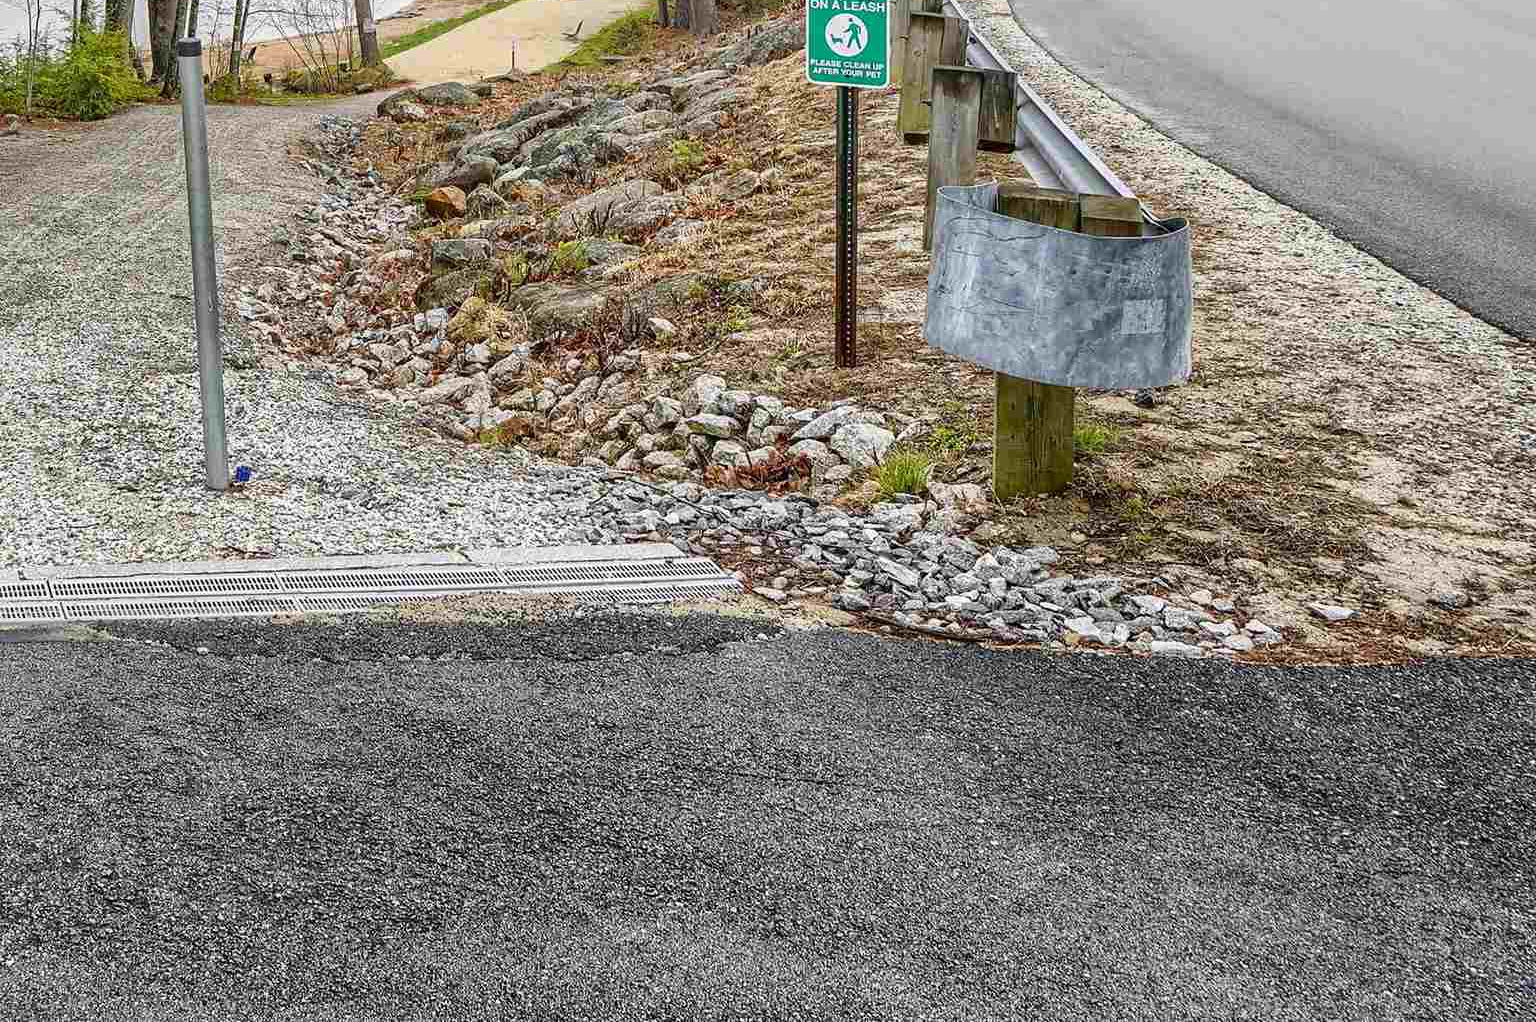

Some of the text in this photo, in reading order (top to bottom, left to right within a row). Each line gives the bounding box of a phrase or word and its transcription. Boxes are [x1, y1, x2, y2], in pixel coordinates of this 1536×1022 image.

[810, 0, 885, 12] ON A LEASH
[810, 59, 884, 71] PLEASE CLEAN UP
[813, 67, 881, 79] AFTER YOUR PET
